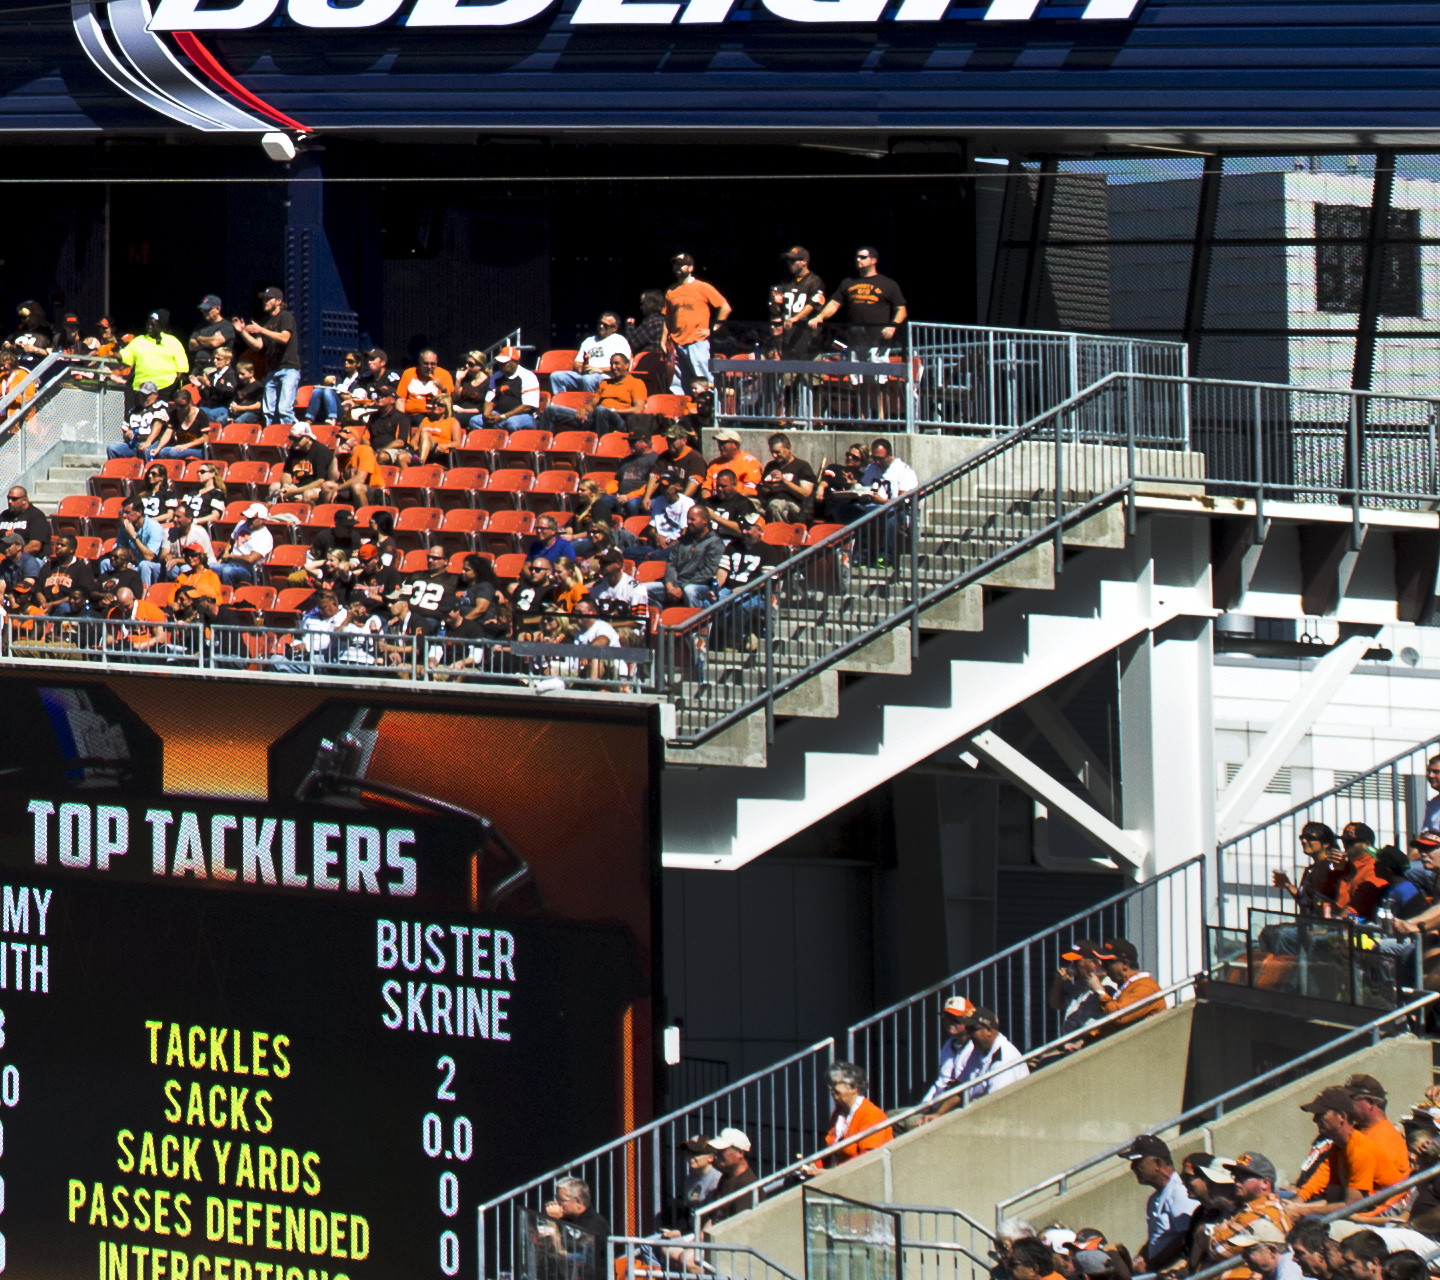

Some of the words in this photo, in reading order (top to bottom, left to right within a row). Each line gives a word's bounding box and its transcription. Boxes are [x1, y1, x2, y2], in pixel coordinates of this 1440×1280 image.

[408, 580, 445, 611] 32
[27, 799, 129, 872] TOP
[145, 808, 418, 897] TACKLERS
[377, 918, 516, 981] BUSTER
[381, 979, 511, 1042] SKRINE
[145, 1020, 291, 1079] TACKLES
[437, 1055, 456, 1101] 2
[164, 1079, 273, 1134] SACKS
[422, 1112, 473, 1162] 0.0
[117, 1129, 203, 1183] SACK
[213, 1140, 321, 1196] YARDS
[439, 1171, 459, 1217] 0
[68, 1178, 192, 1238] PASSES
[206, 1196, 370, 1261] DEFENDED
[439, 1230, 459, 1276] 0
